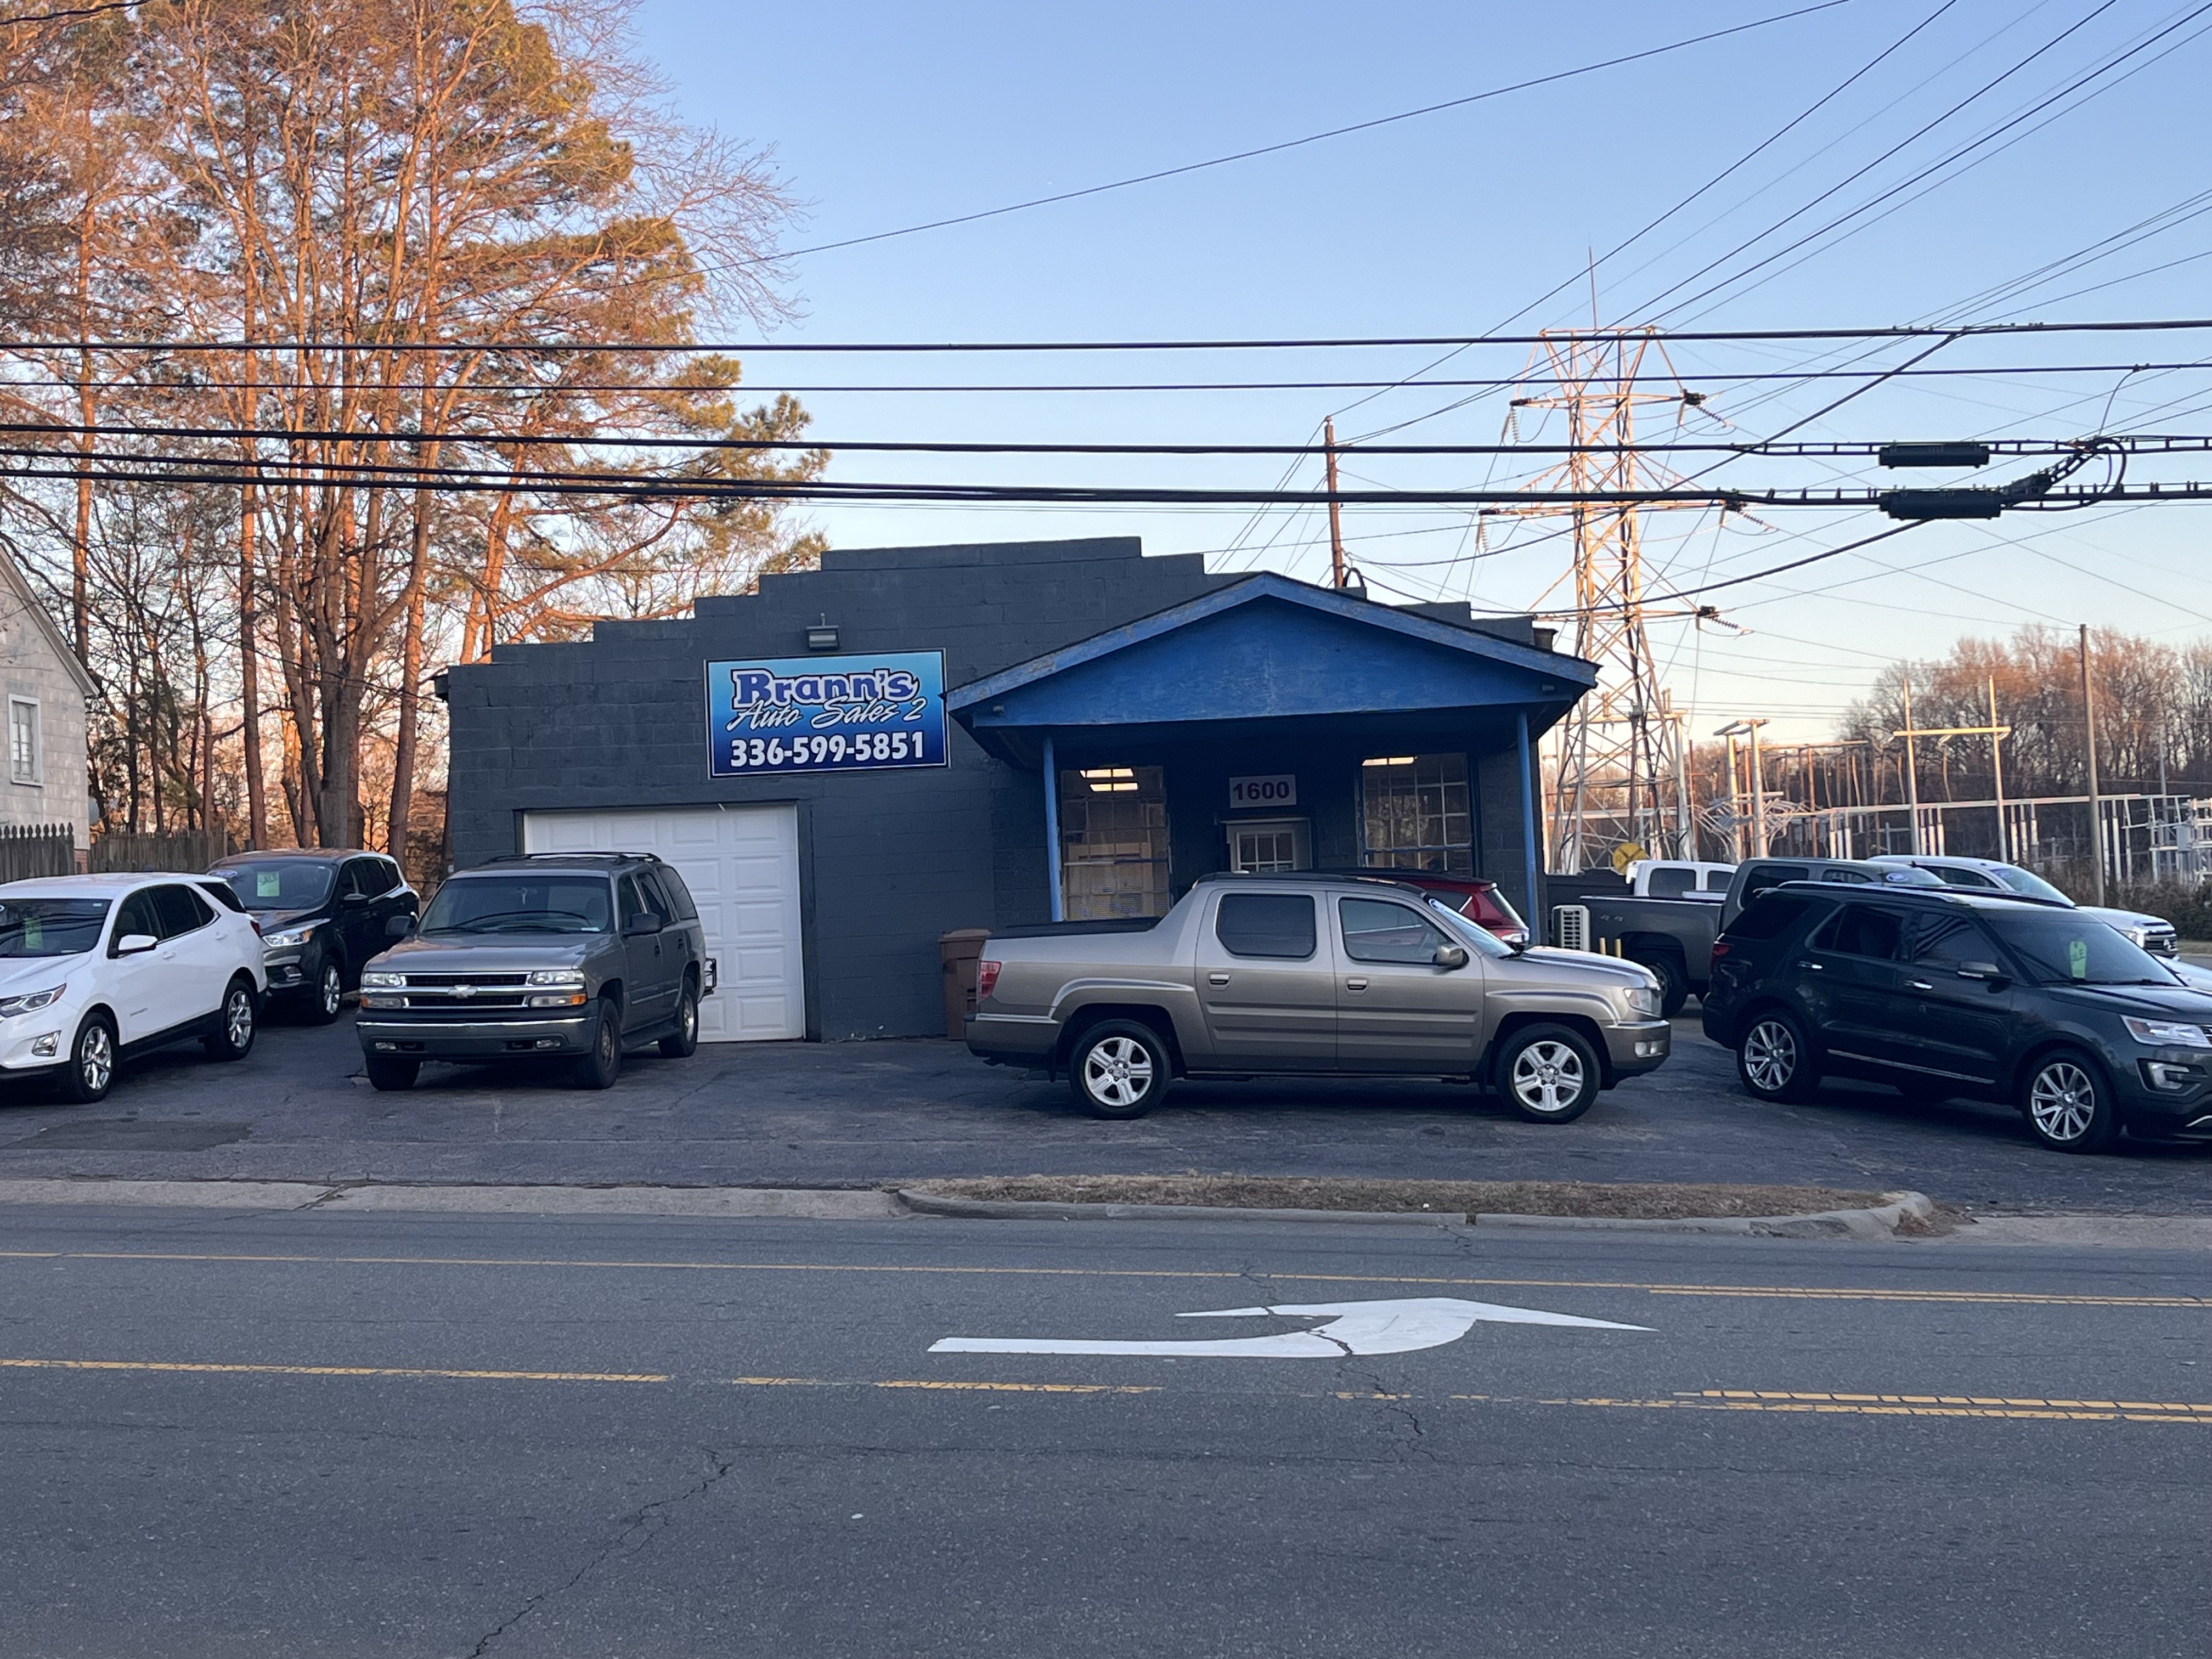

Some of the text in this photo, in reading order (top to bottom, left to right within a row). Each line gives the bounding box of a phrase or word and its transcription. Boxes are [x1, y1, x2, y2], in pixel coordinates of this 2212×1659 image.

[732, 669, 919, 708] Brann's
[725, 695, 927, 732] Auto Sales 2
[730, 731, 923, 767] 336-599-5851
[1233, 781, 1290, 800] 1600
